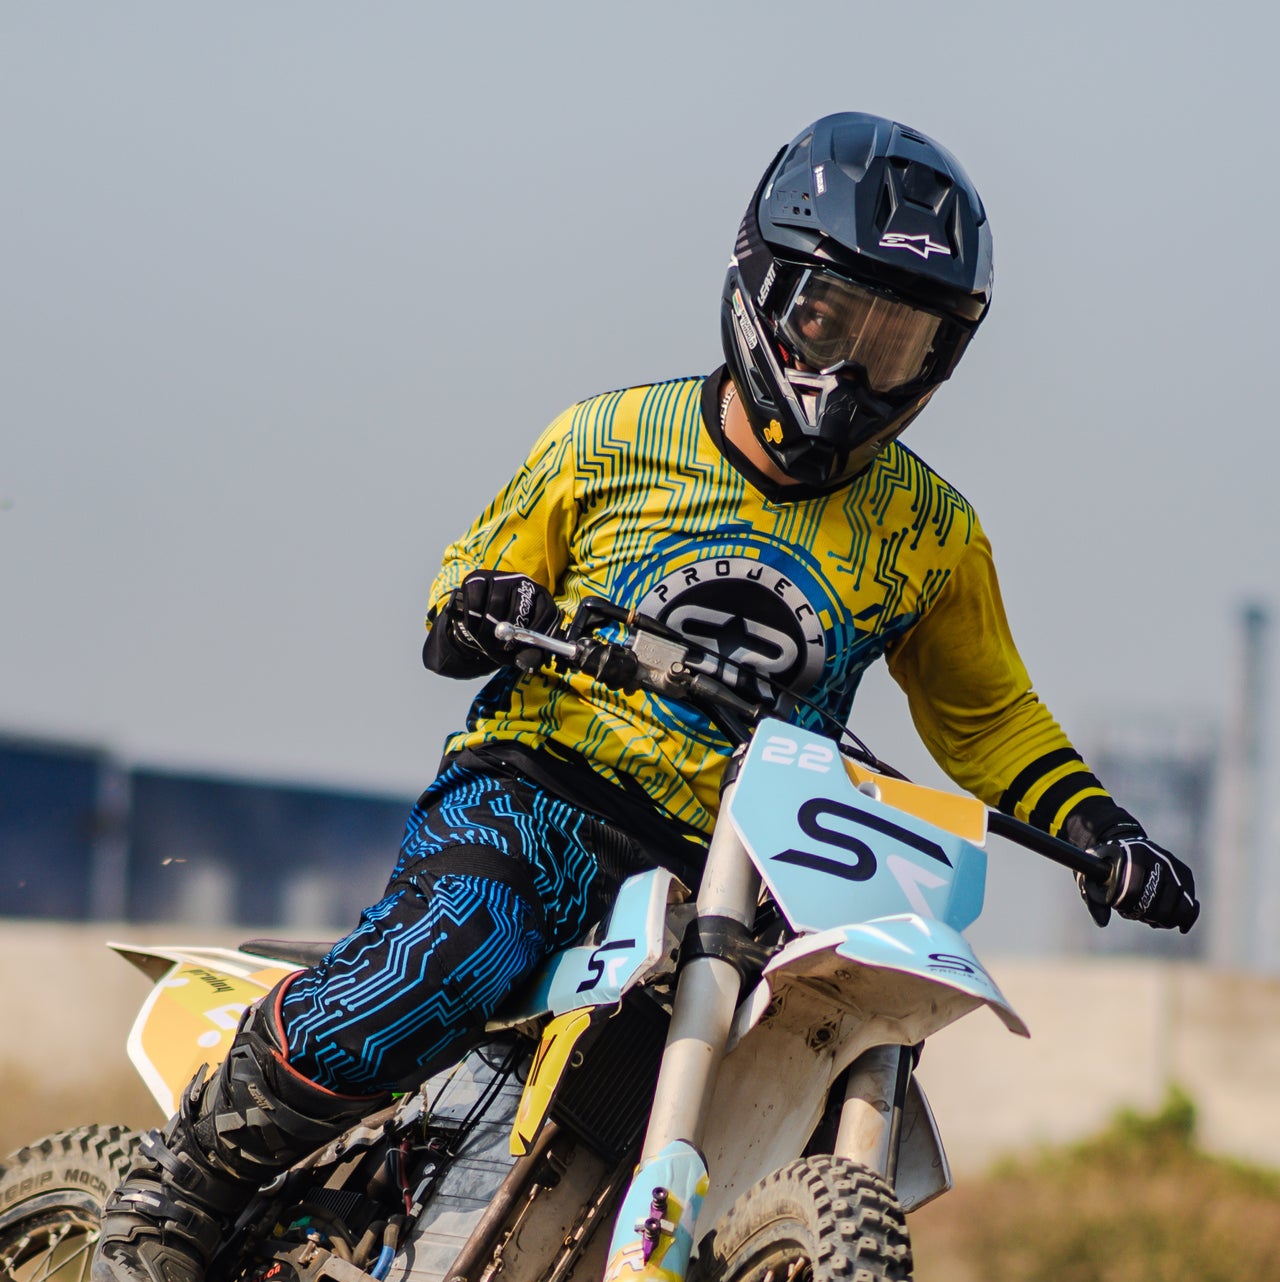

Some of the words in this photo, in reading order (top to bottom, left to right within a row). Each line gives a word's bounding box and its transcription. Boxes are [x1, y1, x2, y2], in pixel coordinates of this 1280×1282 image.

[757, 262, 777, 308] LEATT
[654, 560, 824, 648] PROJECT
[761, 736, 834, 774] 22
